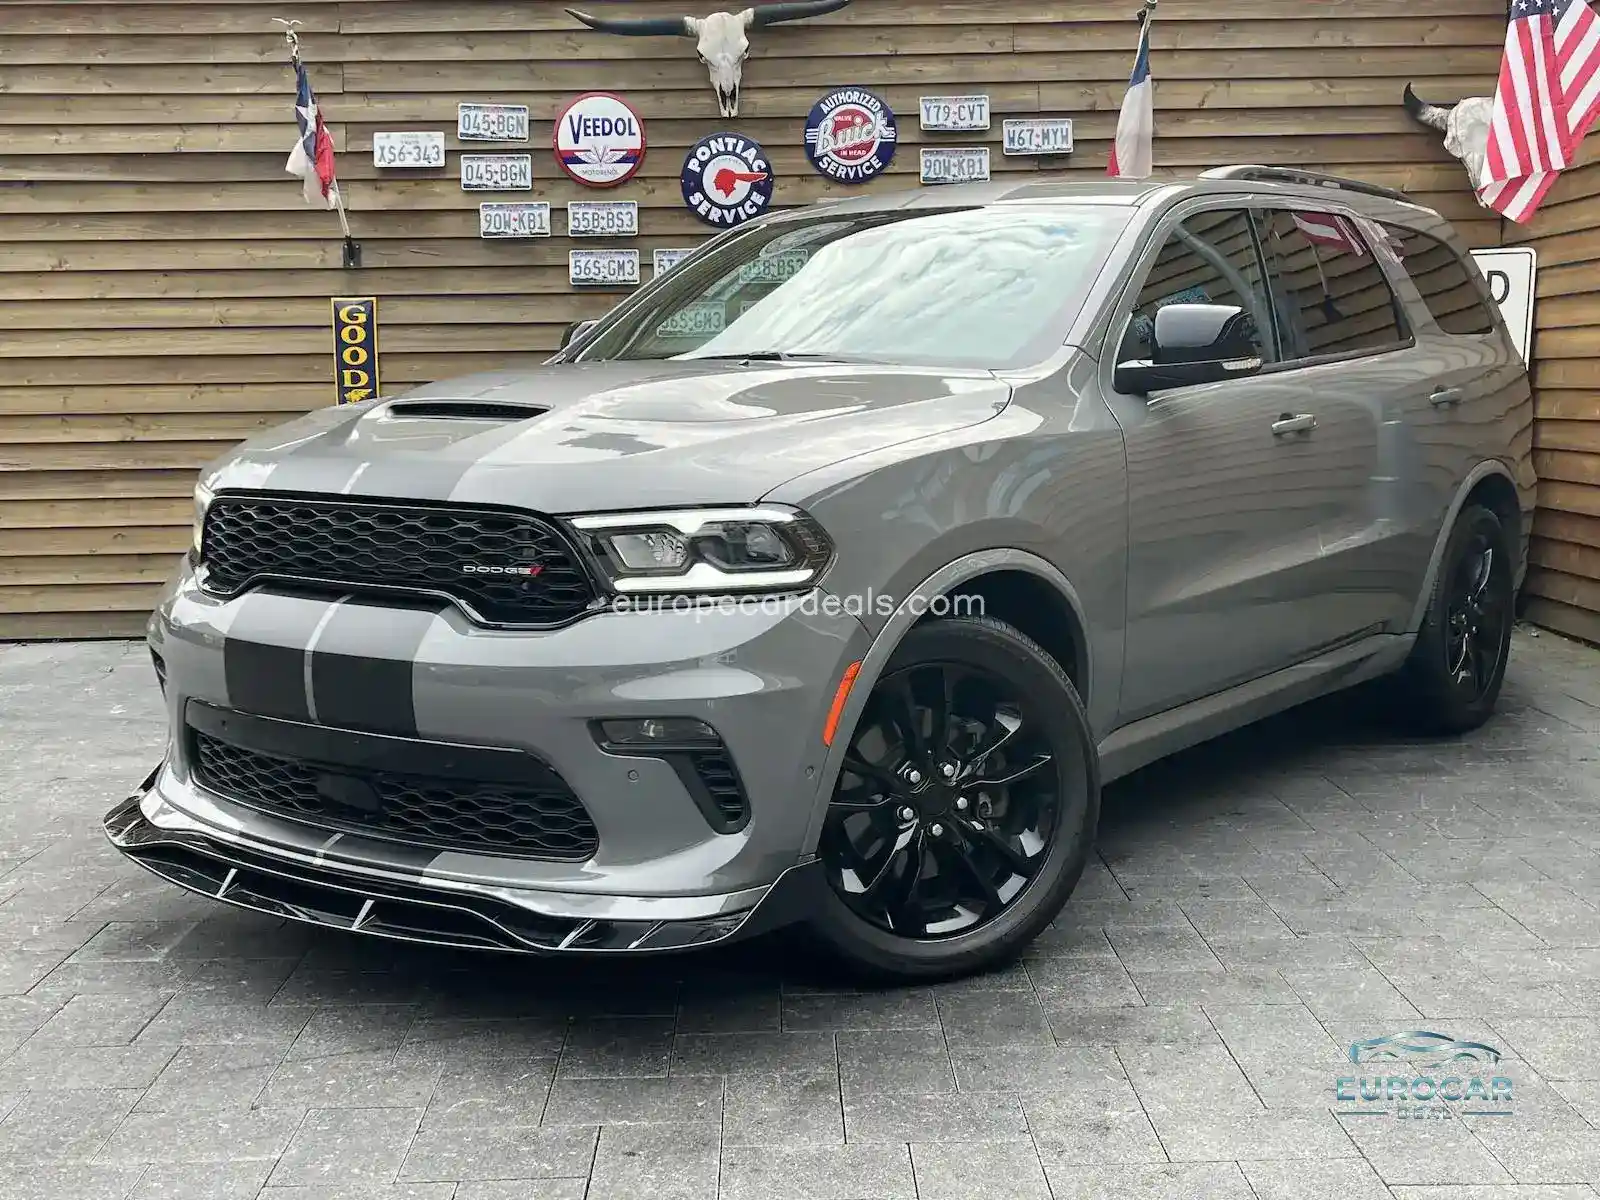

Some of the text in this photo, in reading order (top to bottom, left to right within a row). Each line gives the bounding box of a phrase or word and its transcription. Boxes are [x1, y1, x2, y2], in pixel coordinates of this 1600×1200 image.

[820, 91, 881, 114] AUTHORIZED
[568, 112, 636, 144] VEEDOL
[814, 110, 891, 157] Buick
[687, 137, 767, 173] PONTIAC
[818, 155, 883, 179] SERVICE
[688, 191, 766, 224] SERVICE
[338, 304, 369, 388] GOOD
[463, 565, 531, 575] DODGE
